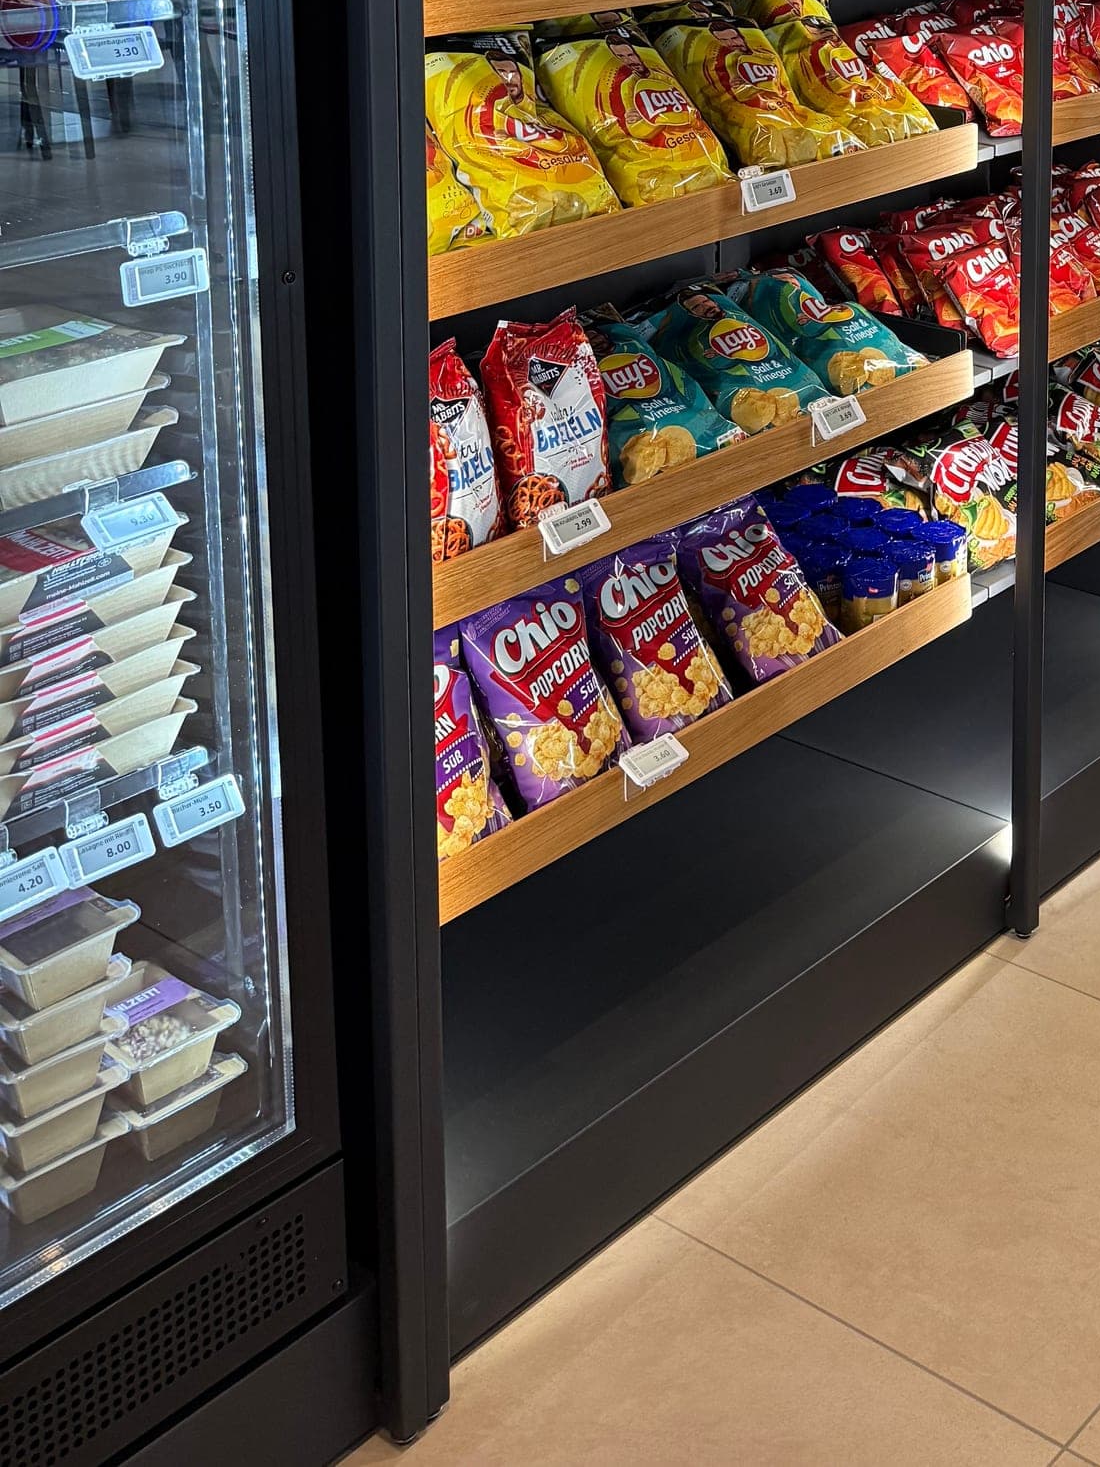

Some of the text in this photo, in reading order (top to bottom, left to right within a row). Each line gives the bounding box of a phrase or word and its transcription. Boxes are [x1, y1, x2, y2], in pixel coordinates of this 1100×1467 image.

[114, 46, 139, 58] 3.30
[968, 42, 1014, 66] Chio
[639, 88, 686, 115] Lay's
[768, 187, 782, 196] 3.69
[928, 233, 974, 261] Chio
[967, 245, 1008, 282] Chio
[164, 271, 187, 284] 3.90
[842, 319, 868, 335] Salt &
[846, 325, 879, 344] Vinegar
[715, 325, 761, 354] Lay's
[603, 358, 652, 392] Lay's
[751, 359, 781, 376] Salt &
[753, 367, 793, 385] Vinegar
[641, 397, 674, 412] Salt &
[644, 403, 687, 423] Vinegar
[839, 410, 852, 421] 3.69
[575, 518, 592, 531] 2.99
[702, 523, 771, 573] Chio
[737, 552, 786, 597] POPCORN
[600, 561, 677, 620] Chio
[633, 592, 690, 651] POPCORN
[494, 601, 577, 674] Chio
[529, 637, 590, 706] POPCORN
[653, 749, 670, 762] 3.60
[199, 800, 222, 817] 3.50
[106, 840, 131, 858] 8.00
[18, 875, 43, 893] 4.20
